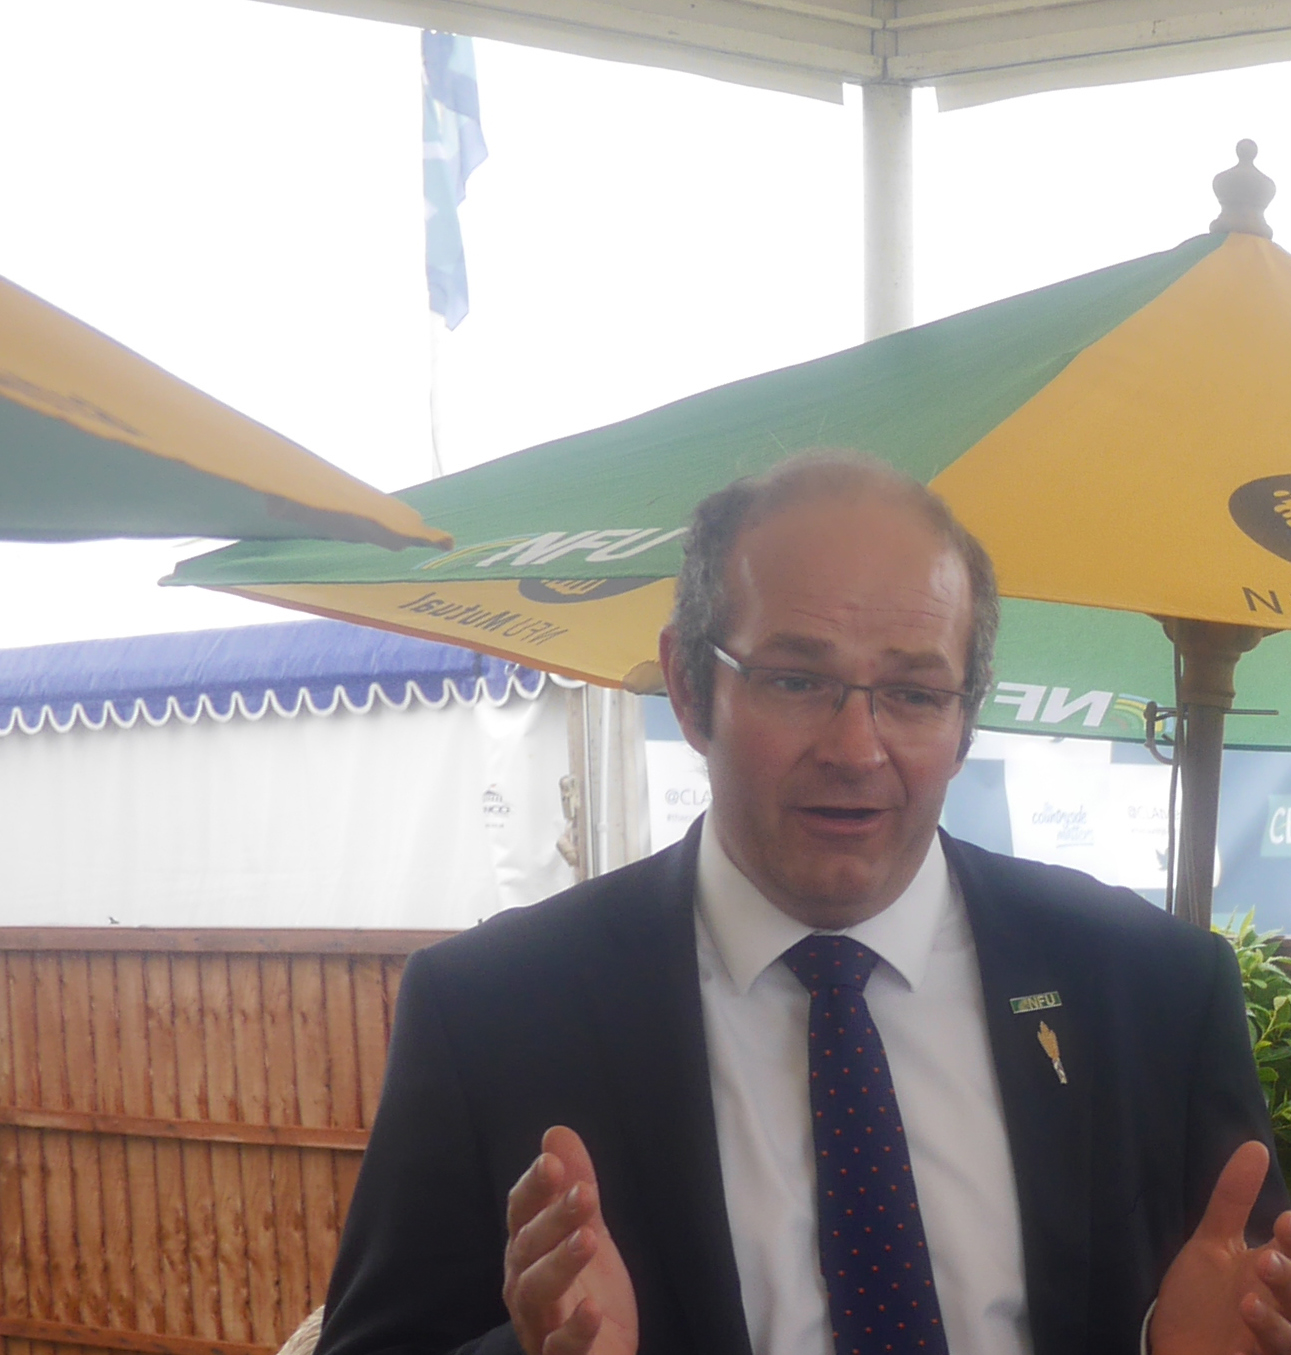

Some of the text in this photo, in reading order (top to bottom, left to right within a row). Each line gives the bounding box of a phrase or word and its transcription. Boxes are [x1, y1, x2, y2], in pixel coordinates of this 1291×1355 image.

[475, 526, 689, 568] NFU
[664, 788, 712, 806] @CLA
[1026, 992, 1056, 1010] NFU
